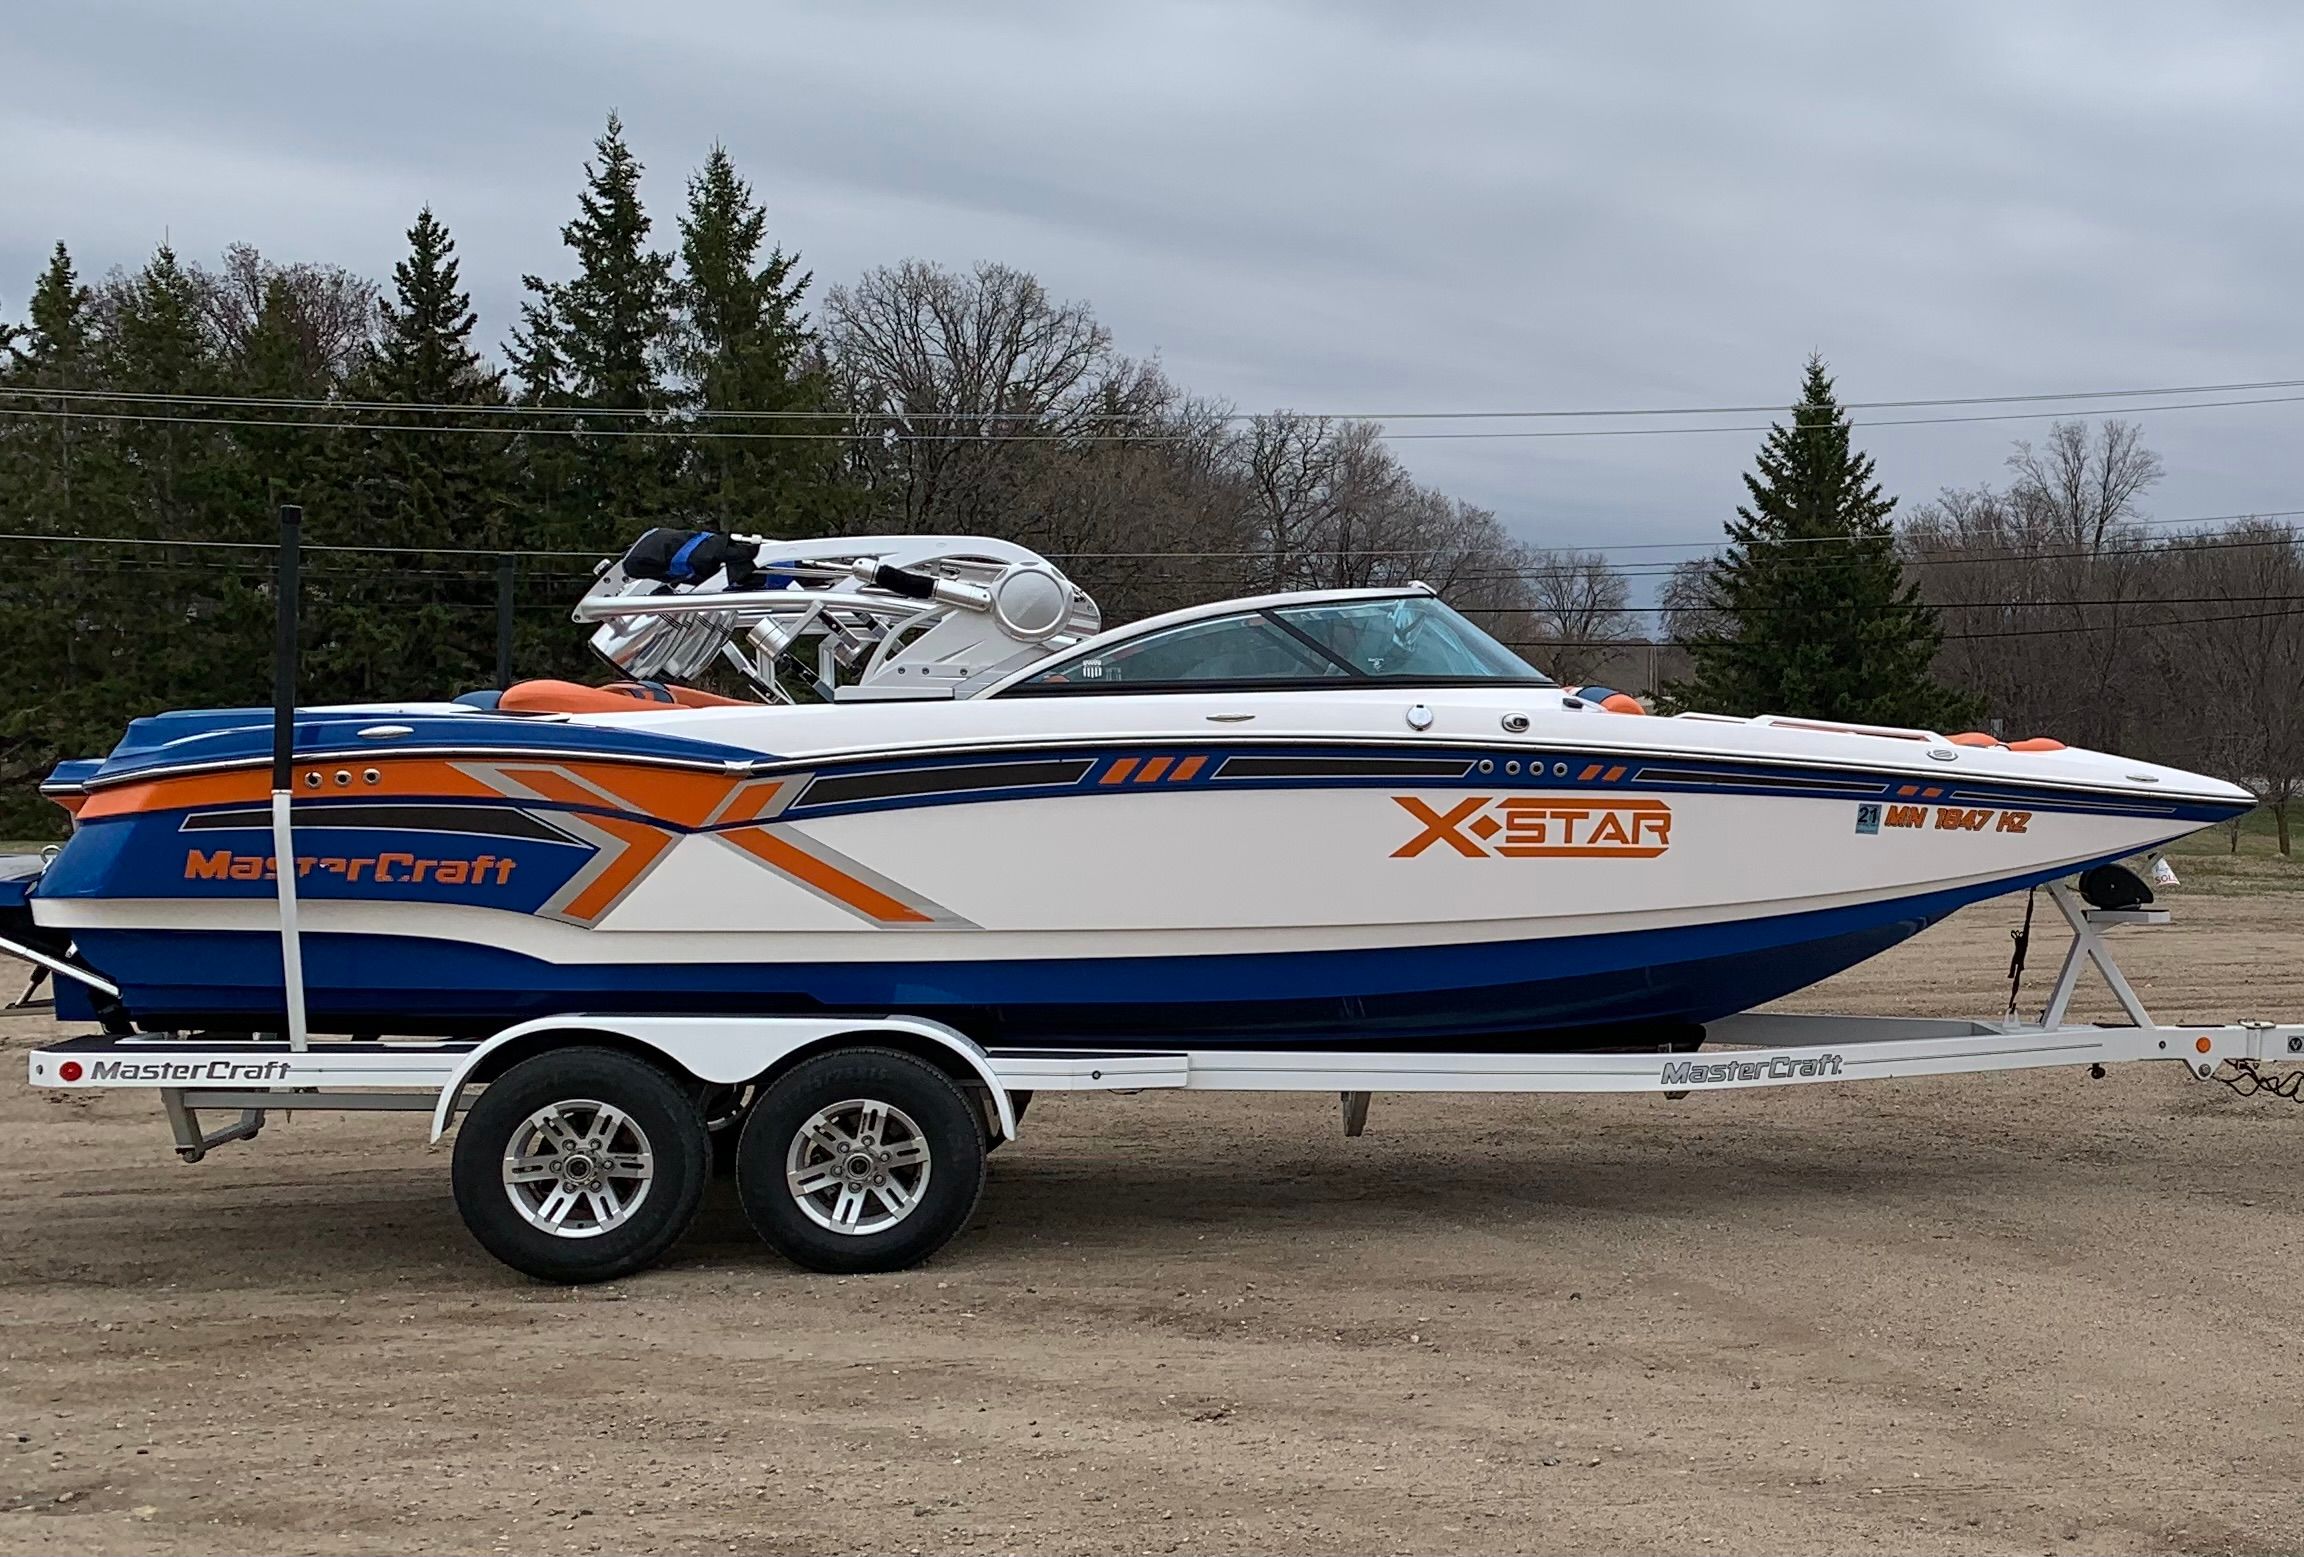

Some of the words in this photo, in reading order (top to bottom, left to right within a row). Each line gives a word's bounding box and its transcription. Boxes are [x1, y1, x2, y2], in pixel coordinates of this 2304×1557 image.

[1858, 807, 1877, 824] 21
[1884, 805, 1928, 829] MN
[1934, 807, 1994, 832] 1847
[1996, 811, 2032, 833] KZ
[2155, 874, 2178, 885] SOL
[90, 1061, 291, 1080] MasterCraft
[1661, 1054, 1842, 1084] MasterCraft
